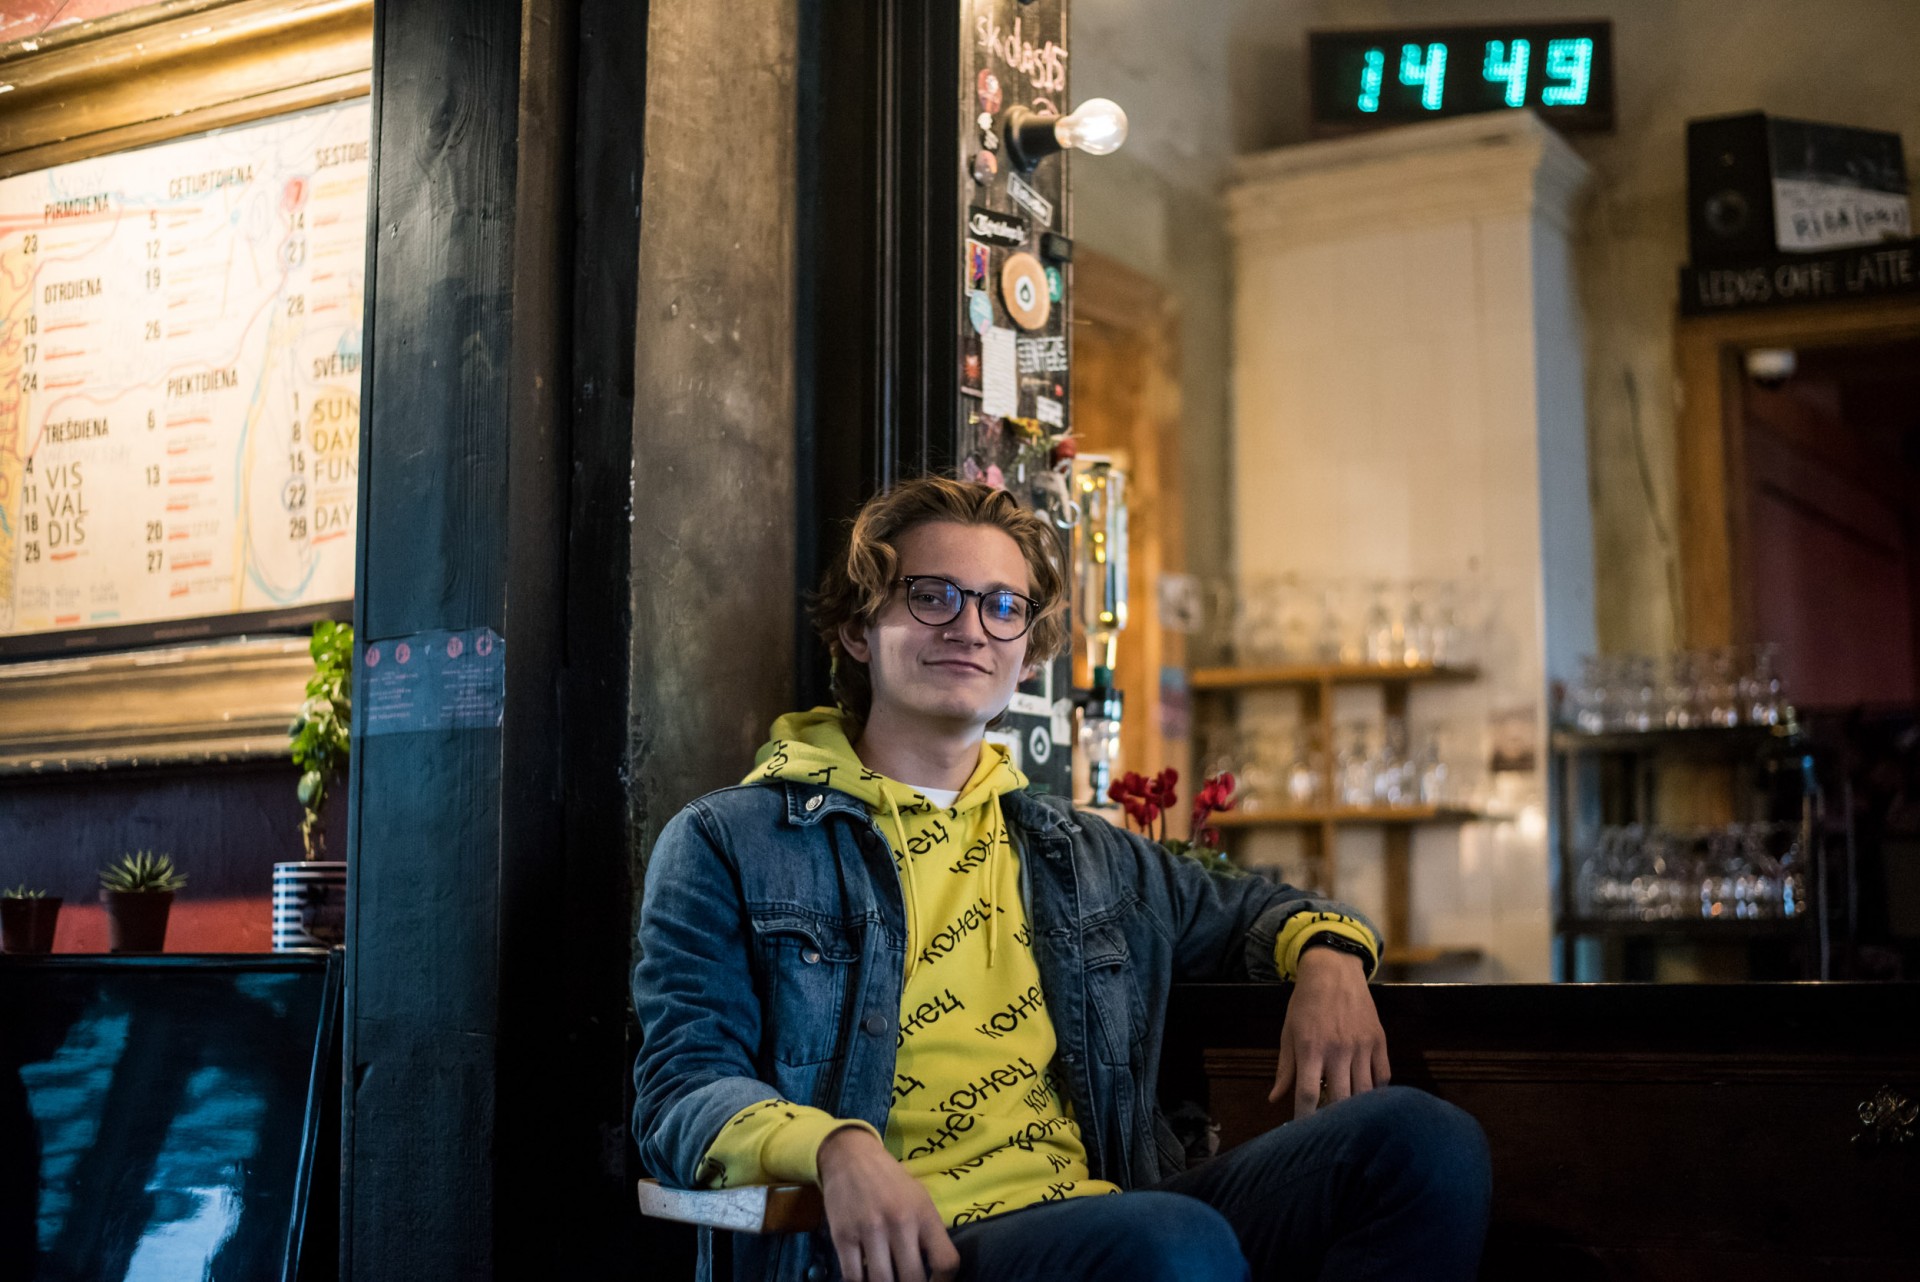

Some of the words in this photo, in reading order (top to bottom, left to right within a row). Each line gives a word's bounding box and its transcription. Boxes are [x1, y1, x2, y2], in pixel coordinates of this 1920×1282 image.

[1358, 43, 1448, 112] 14
[1482, 38, 1593, 107] 49
[44, 193, 110, 223] PIRMDIENA
[23, 235, 38, 254] 23
[146, 240, 161, 260] 12
[44, 278, 103, 304] OTRDIENA
[146, 269, 161, 289] 19
[24, 315, 37, 335] 10
[23, 344, 37, 363] 17
[22, 373, 38, 393] 24
[167, 368, 239, 398] PIEKTDIENA
[44, 416, 110, 445] TREŠDIENA
[314, 428, 357, 454] DAY
[46, 461, 83, 490] VIS
[146, 465, 161, 486] 13
[46, 492, 89, 518] VAL
[314, 503, 354, 532] DAY
[49, 515, 86, 548] DIS
[147, 521, 163, 542] 20
[147, 551, 163, 573] 27
